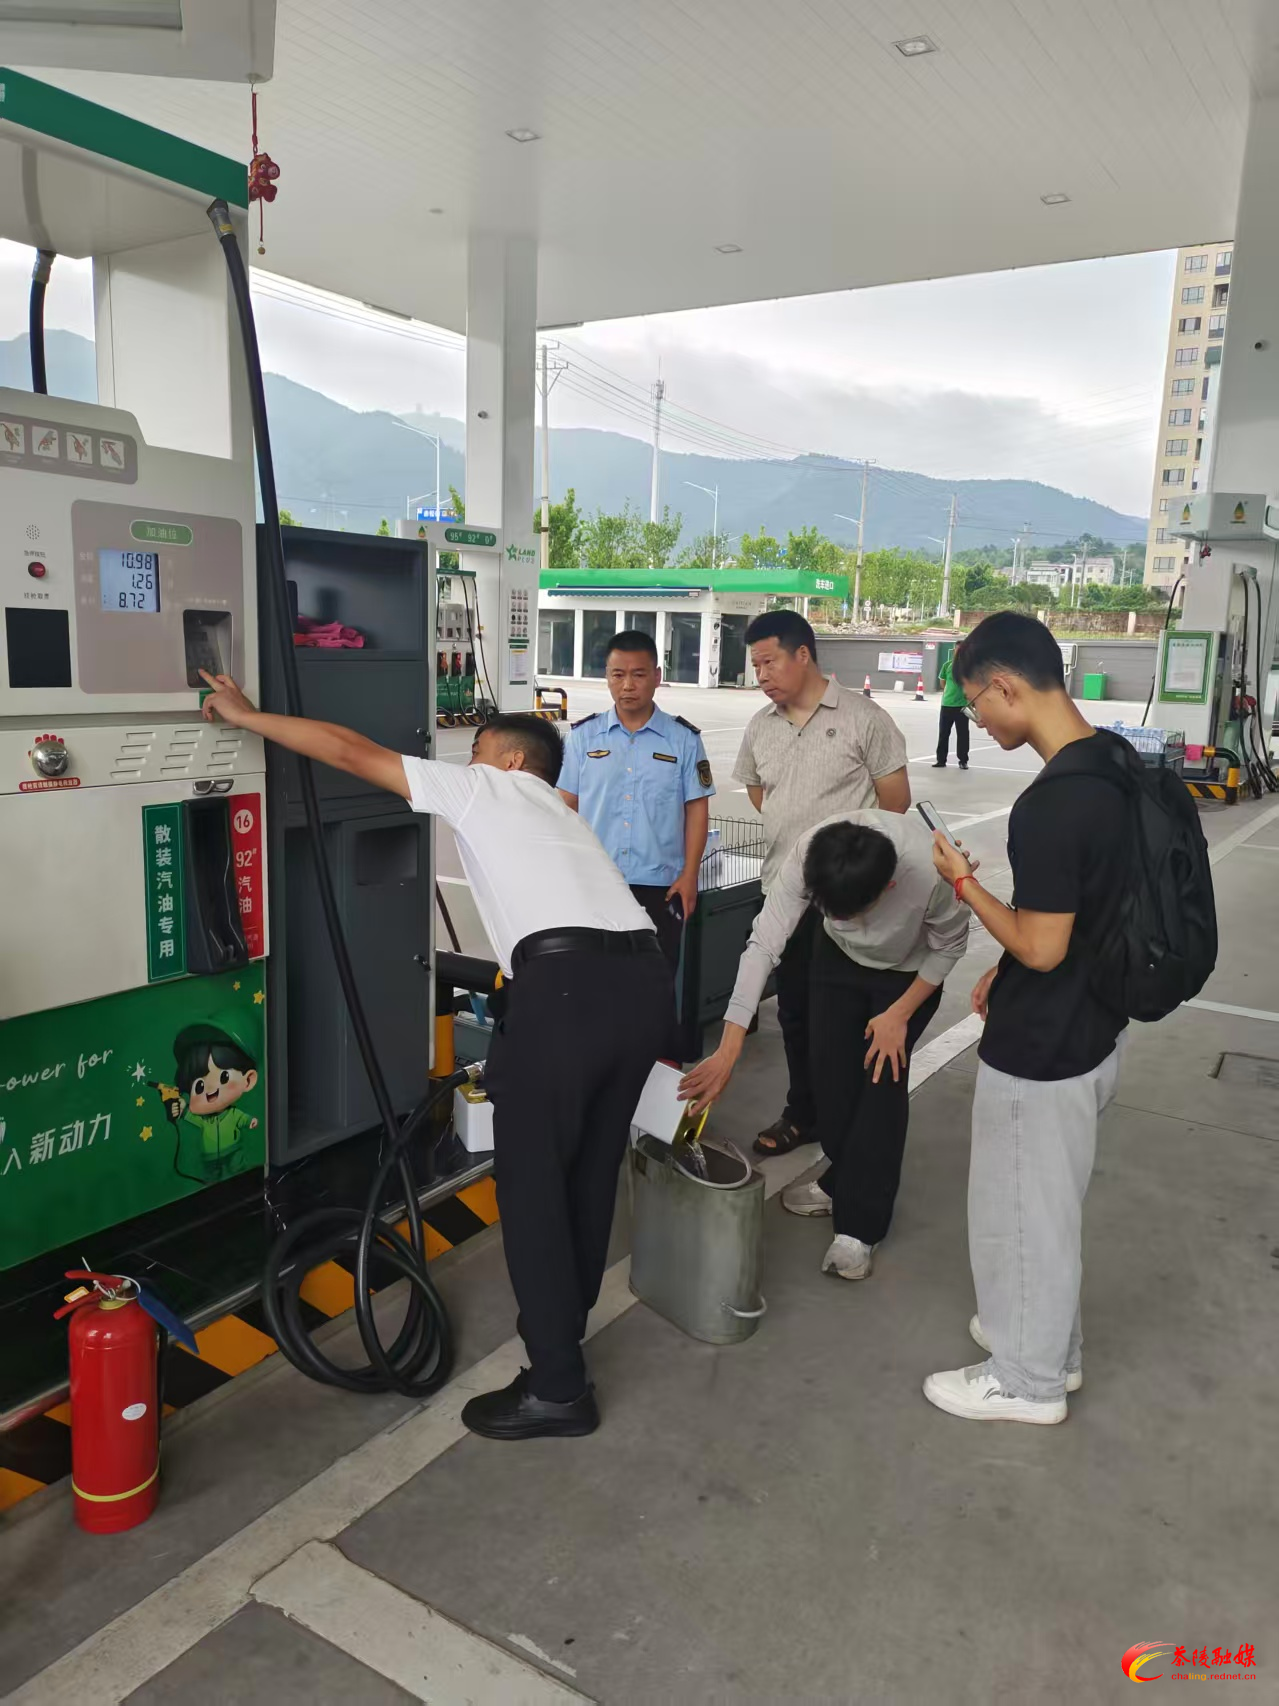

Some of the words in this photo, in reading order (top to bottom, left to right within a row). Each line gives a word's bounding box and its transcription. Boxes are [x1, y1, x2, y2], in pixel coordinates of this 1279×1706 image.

[121, 553, 153, 570] 10.98
[132, 573, 153, 590] 1.26
[119, 592, 145, 609] 8.72
[236, 815, 250, 829] 16
[154, 824, 175, 959] 散装汽油专用
[238, 875, 253, 914] 汽油
[0, 1063, 66, 1091] ower
[77, 1049, 113, 1079] for
[0, 1112, 112, 1176] 入新动力
